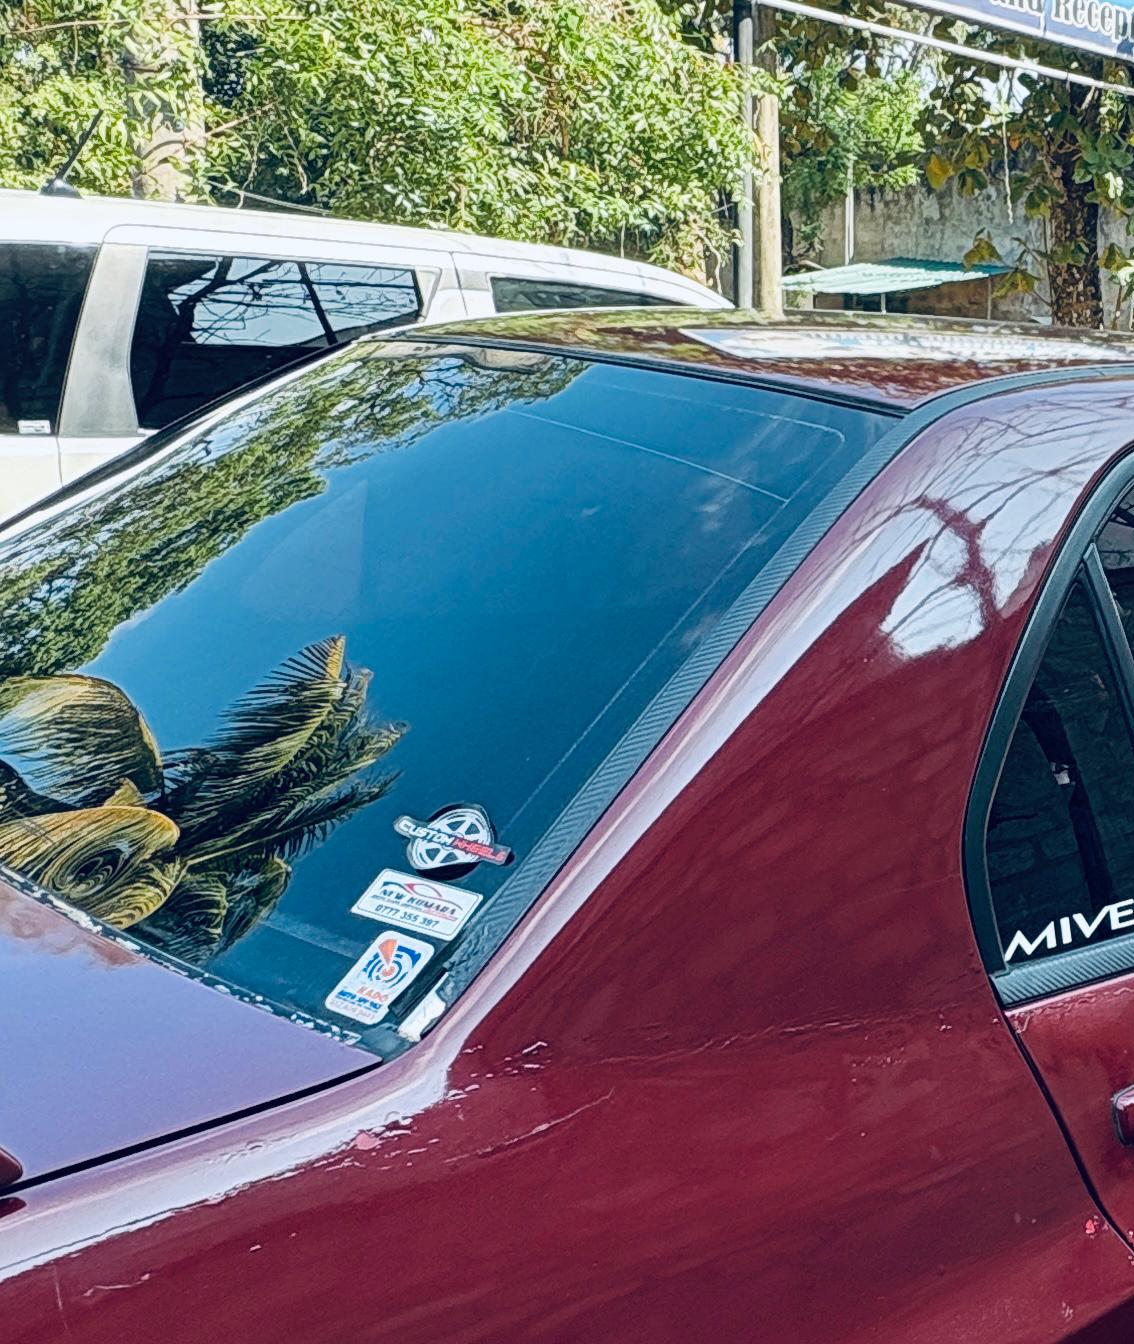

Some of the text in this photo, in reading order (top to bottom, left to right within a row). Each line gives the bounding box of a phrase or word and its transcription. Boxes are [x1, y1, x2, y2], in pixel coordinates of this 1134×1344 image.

[399, 819, 456, 846] CUSTOM
[382, 889, 407, 900] NEW
[374, 904, 399, 916] 0777
[400, 911, 418, 922] 355
[420, 916, 440, 928] 397
